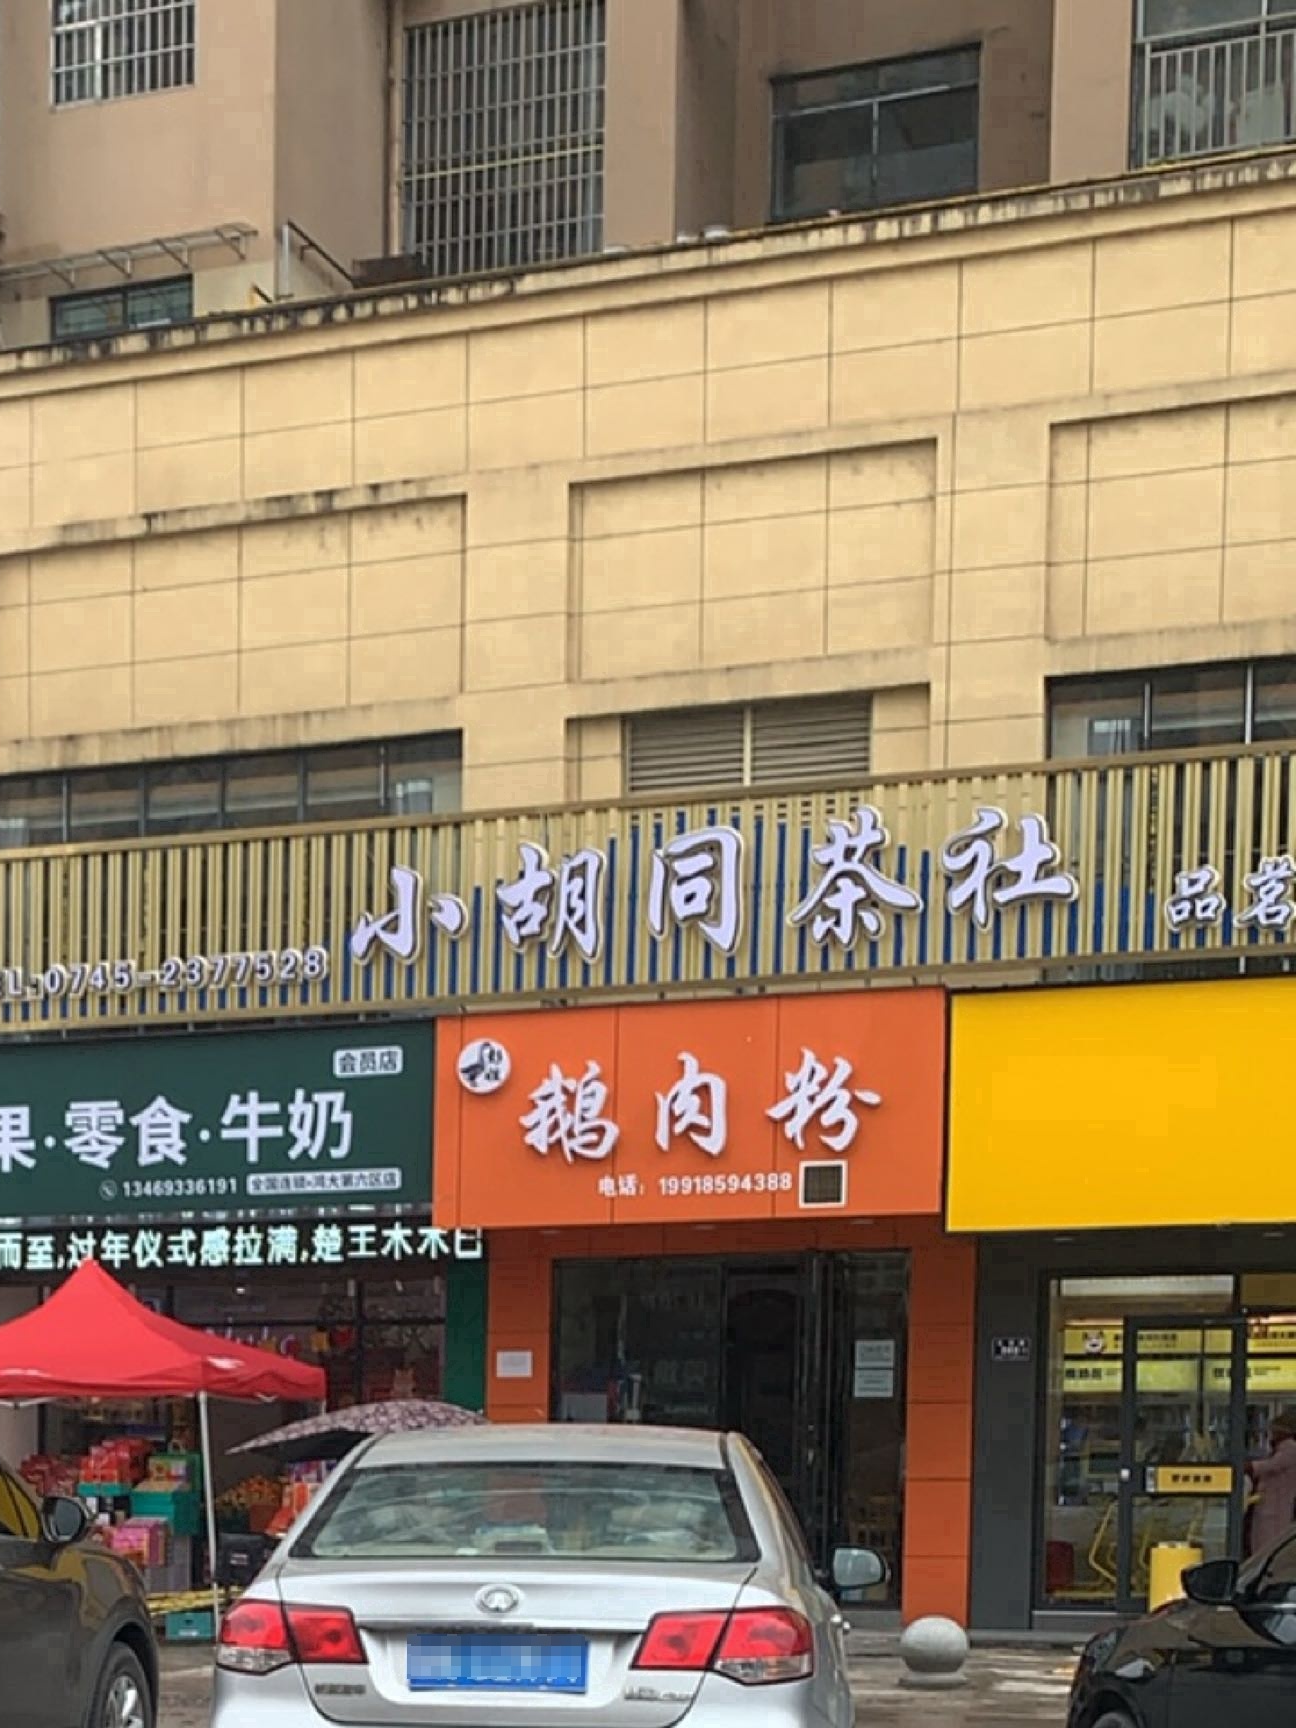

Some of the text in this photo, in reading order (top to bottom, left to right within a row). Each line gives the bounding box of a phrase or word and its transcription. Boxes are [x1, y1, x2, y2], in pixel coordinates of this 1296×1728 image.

[352, 806, 1078, 964] 小胡同茶社
[339, 1050, 398, 1074] 会员店
[519, 1047, 882, 1165] 鹅肉粉
[123, 1176, 238, 1197] 13469336191
[659, 1172, 793, 1196] 19918594388
